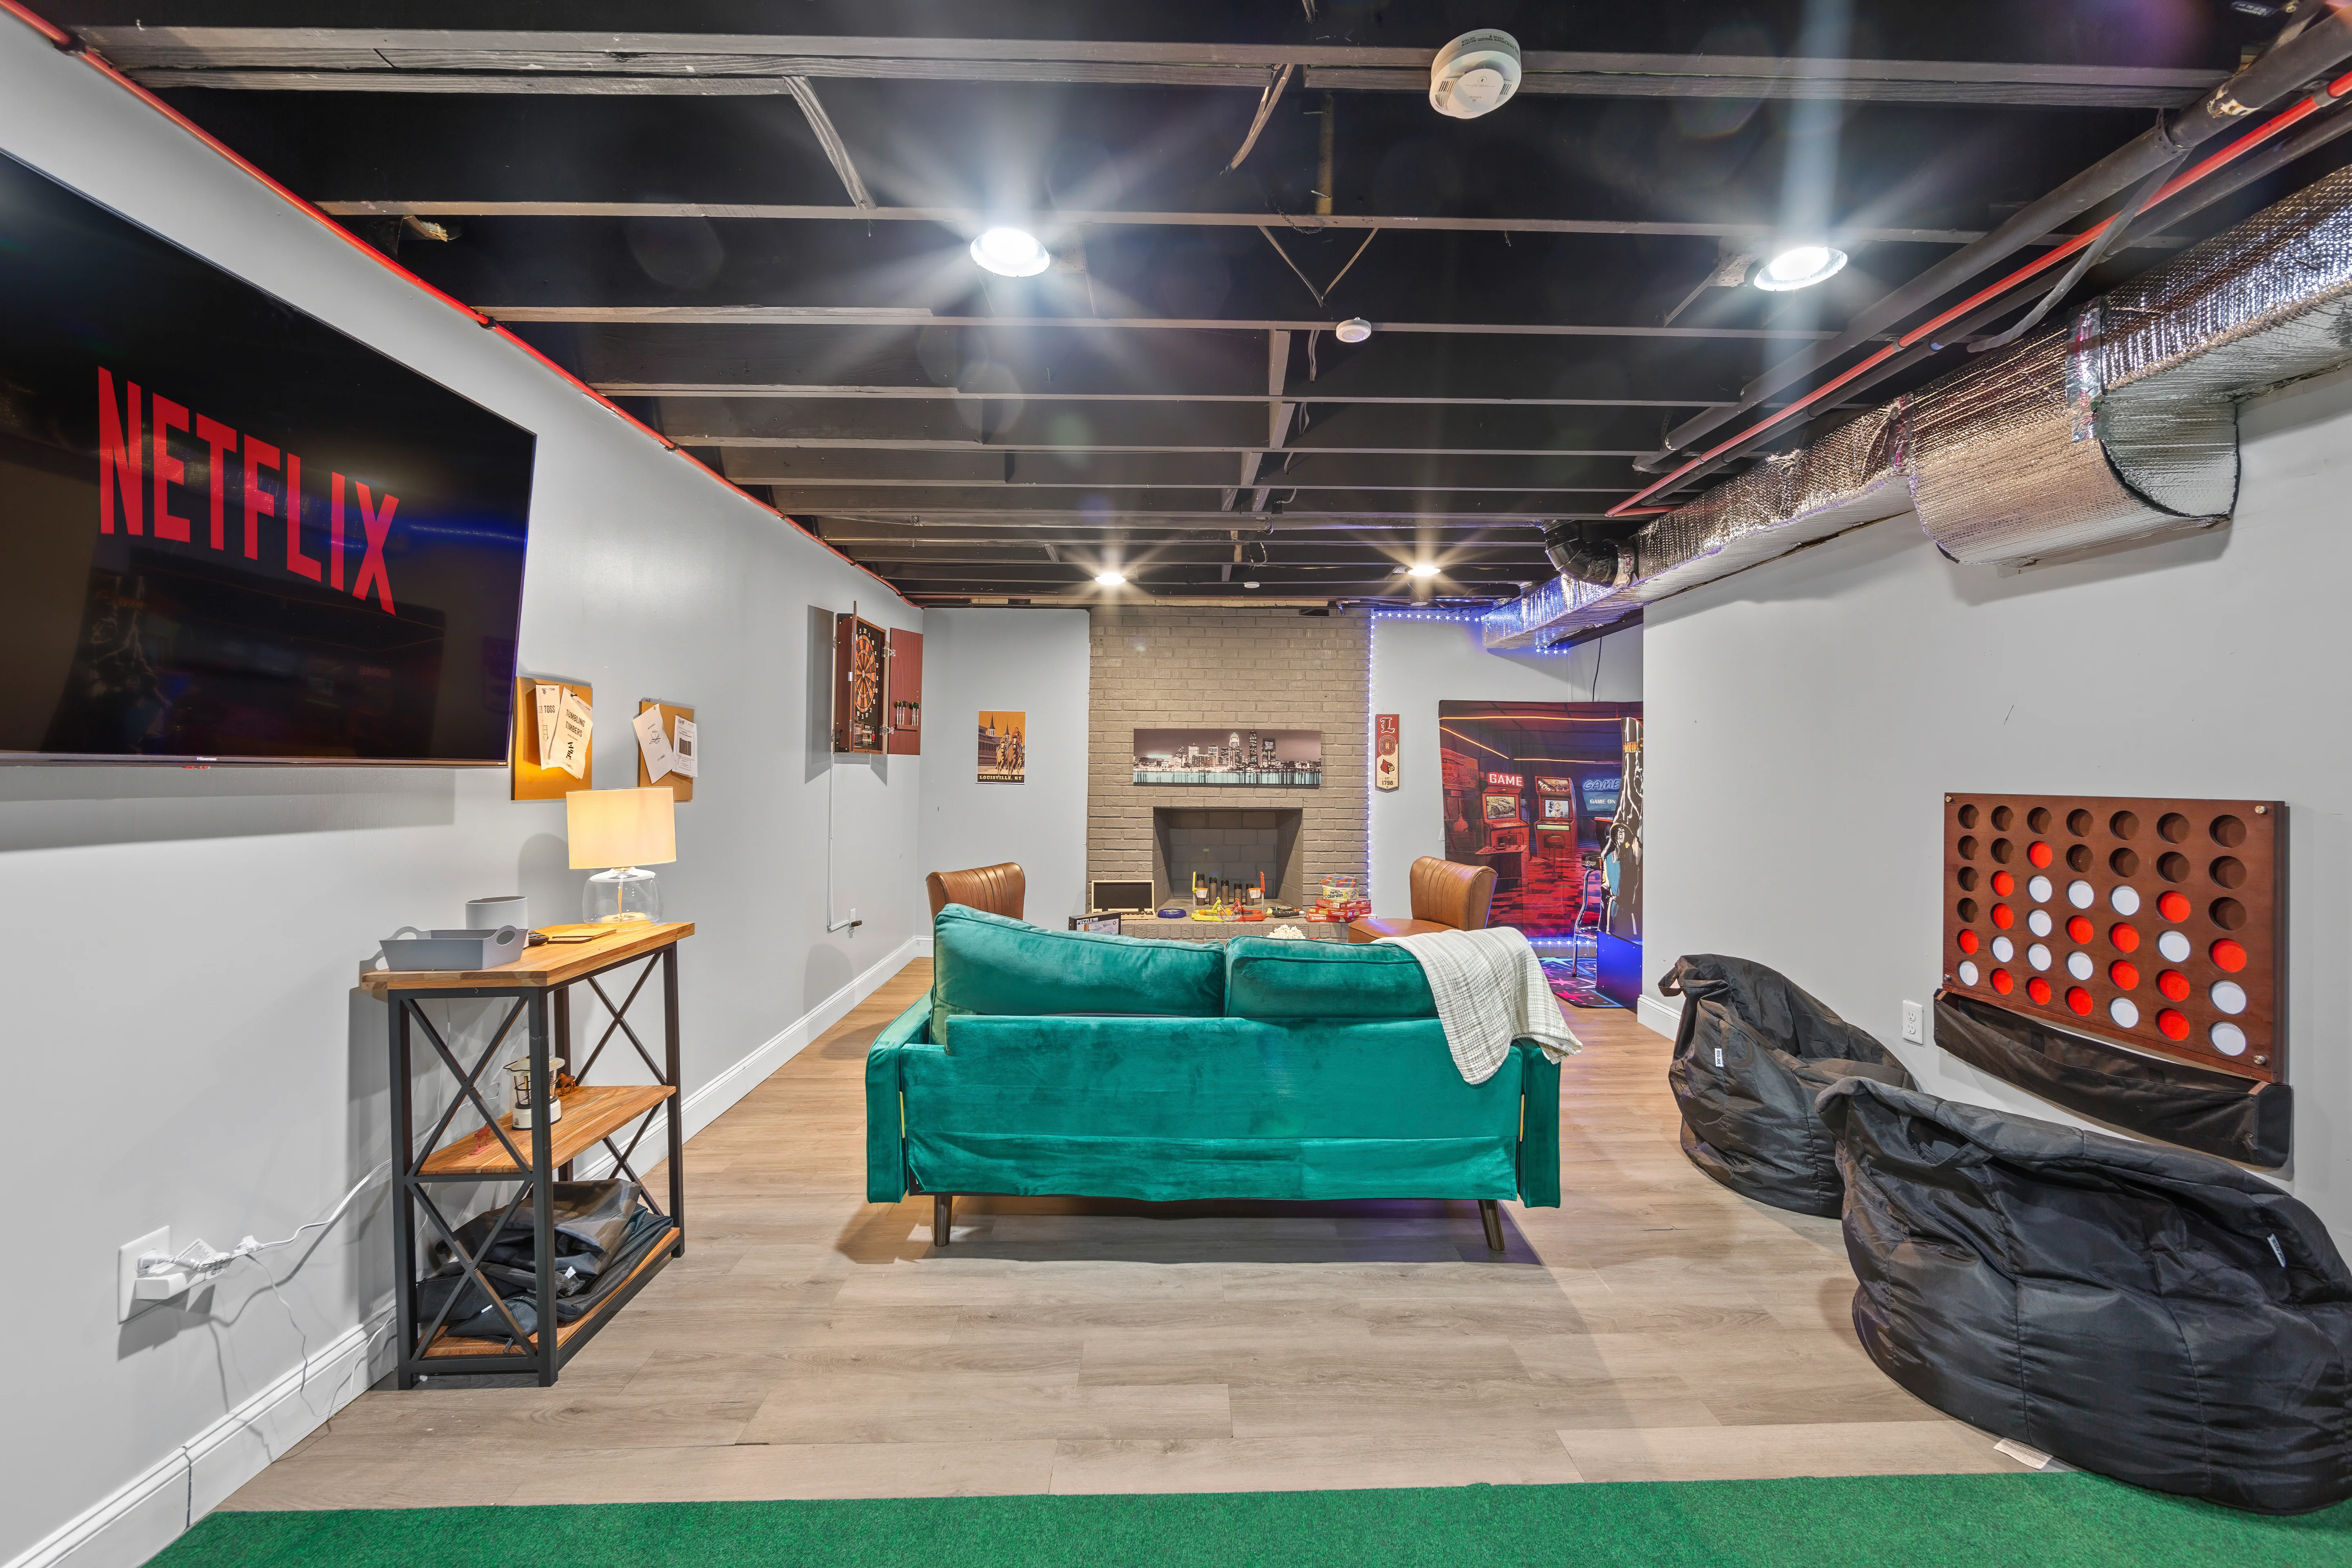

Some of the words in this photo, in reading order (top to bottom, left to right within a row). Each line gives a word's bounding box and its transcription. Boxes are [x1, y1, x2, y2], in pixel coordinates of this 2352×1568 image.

[98, 366, 399, 616] NETFLIX
[566, 709, 586, 727] TUMBLING
[566, 721, 583, 737] TIMBERS
[1489, 773, 1523, 786] GAME
[1584, 780, 1621, 790] GAME
